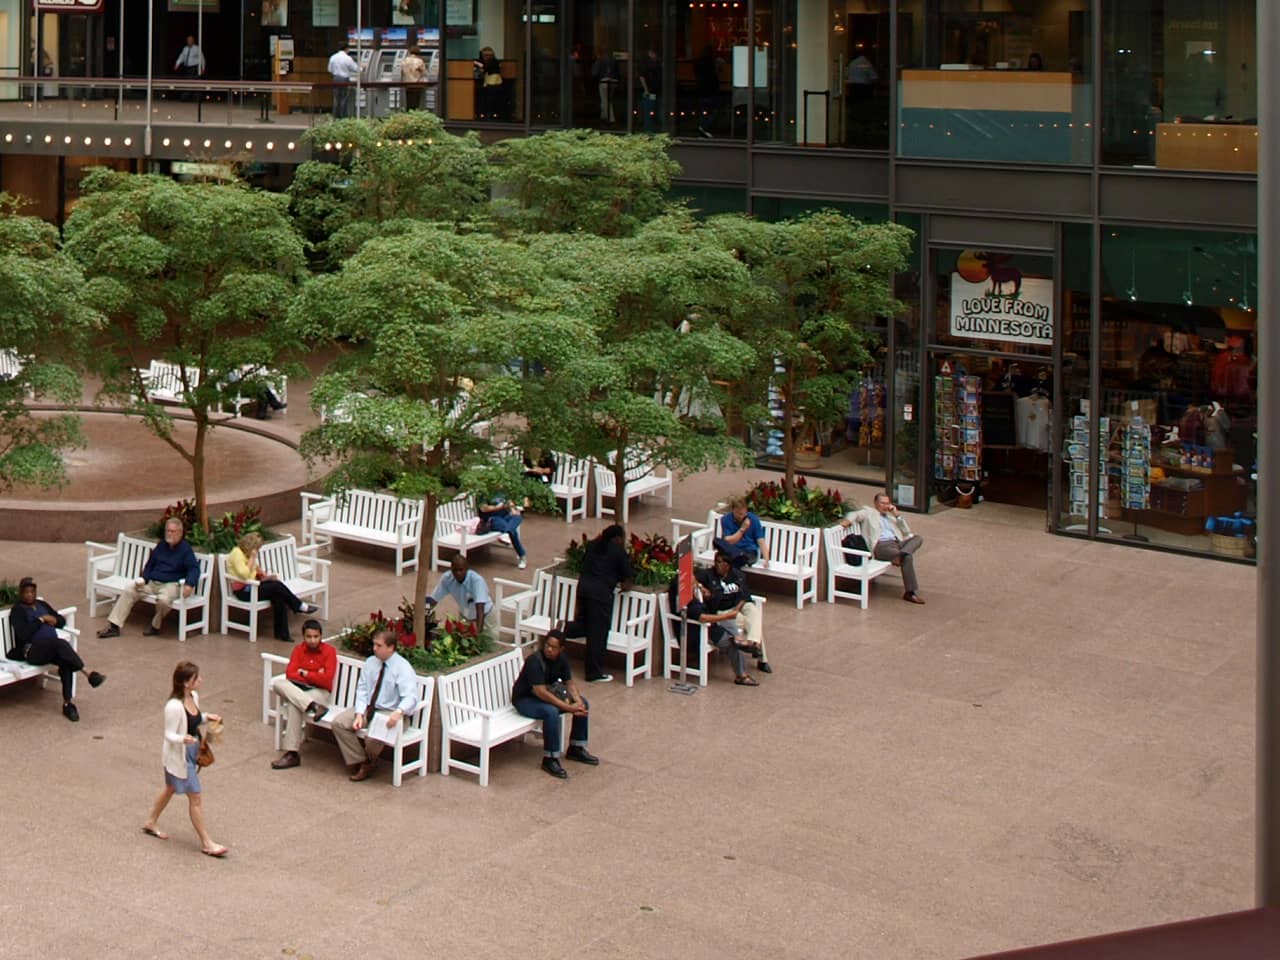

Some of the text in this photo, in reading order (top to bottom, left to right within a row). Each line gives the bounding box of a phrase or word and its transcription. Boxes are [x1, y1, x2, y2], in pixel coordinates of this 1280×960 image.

[961, 297, 1049, 322] LOVE FROM
[954, 315, 1053, 339] MINNESOTA
